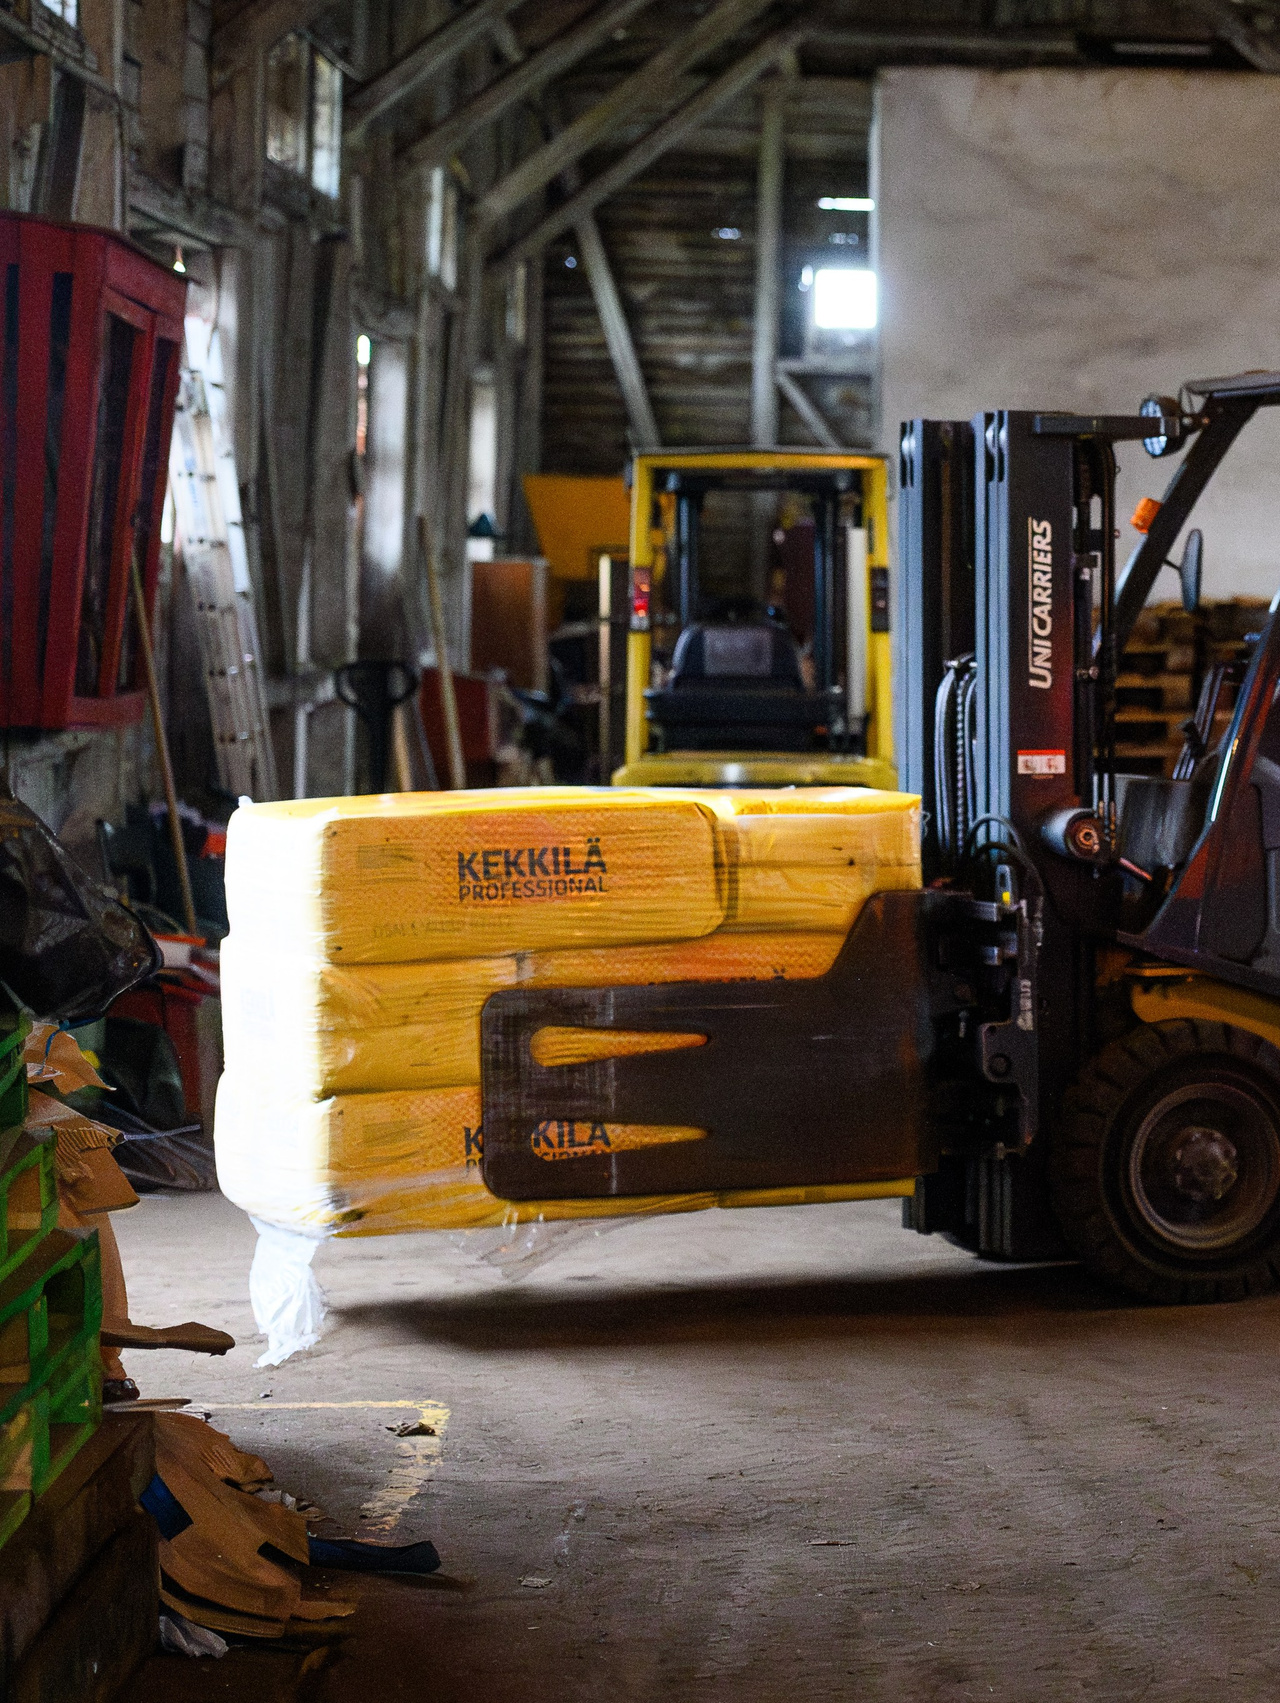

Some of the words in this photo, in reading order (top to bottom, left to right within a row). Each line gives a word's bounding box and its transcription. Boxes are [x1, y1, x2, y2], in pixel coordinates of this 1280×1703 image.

[1028, 517, 1053, 689] UNICARRIERS
[457, 837, 608, 883] KEKKILÄ
[458, 875, 609, 902] PROFESSIONAL
